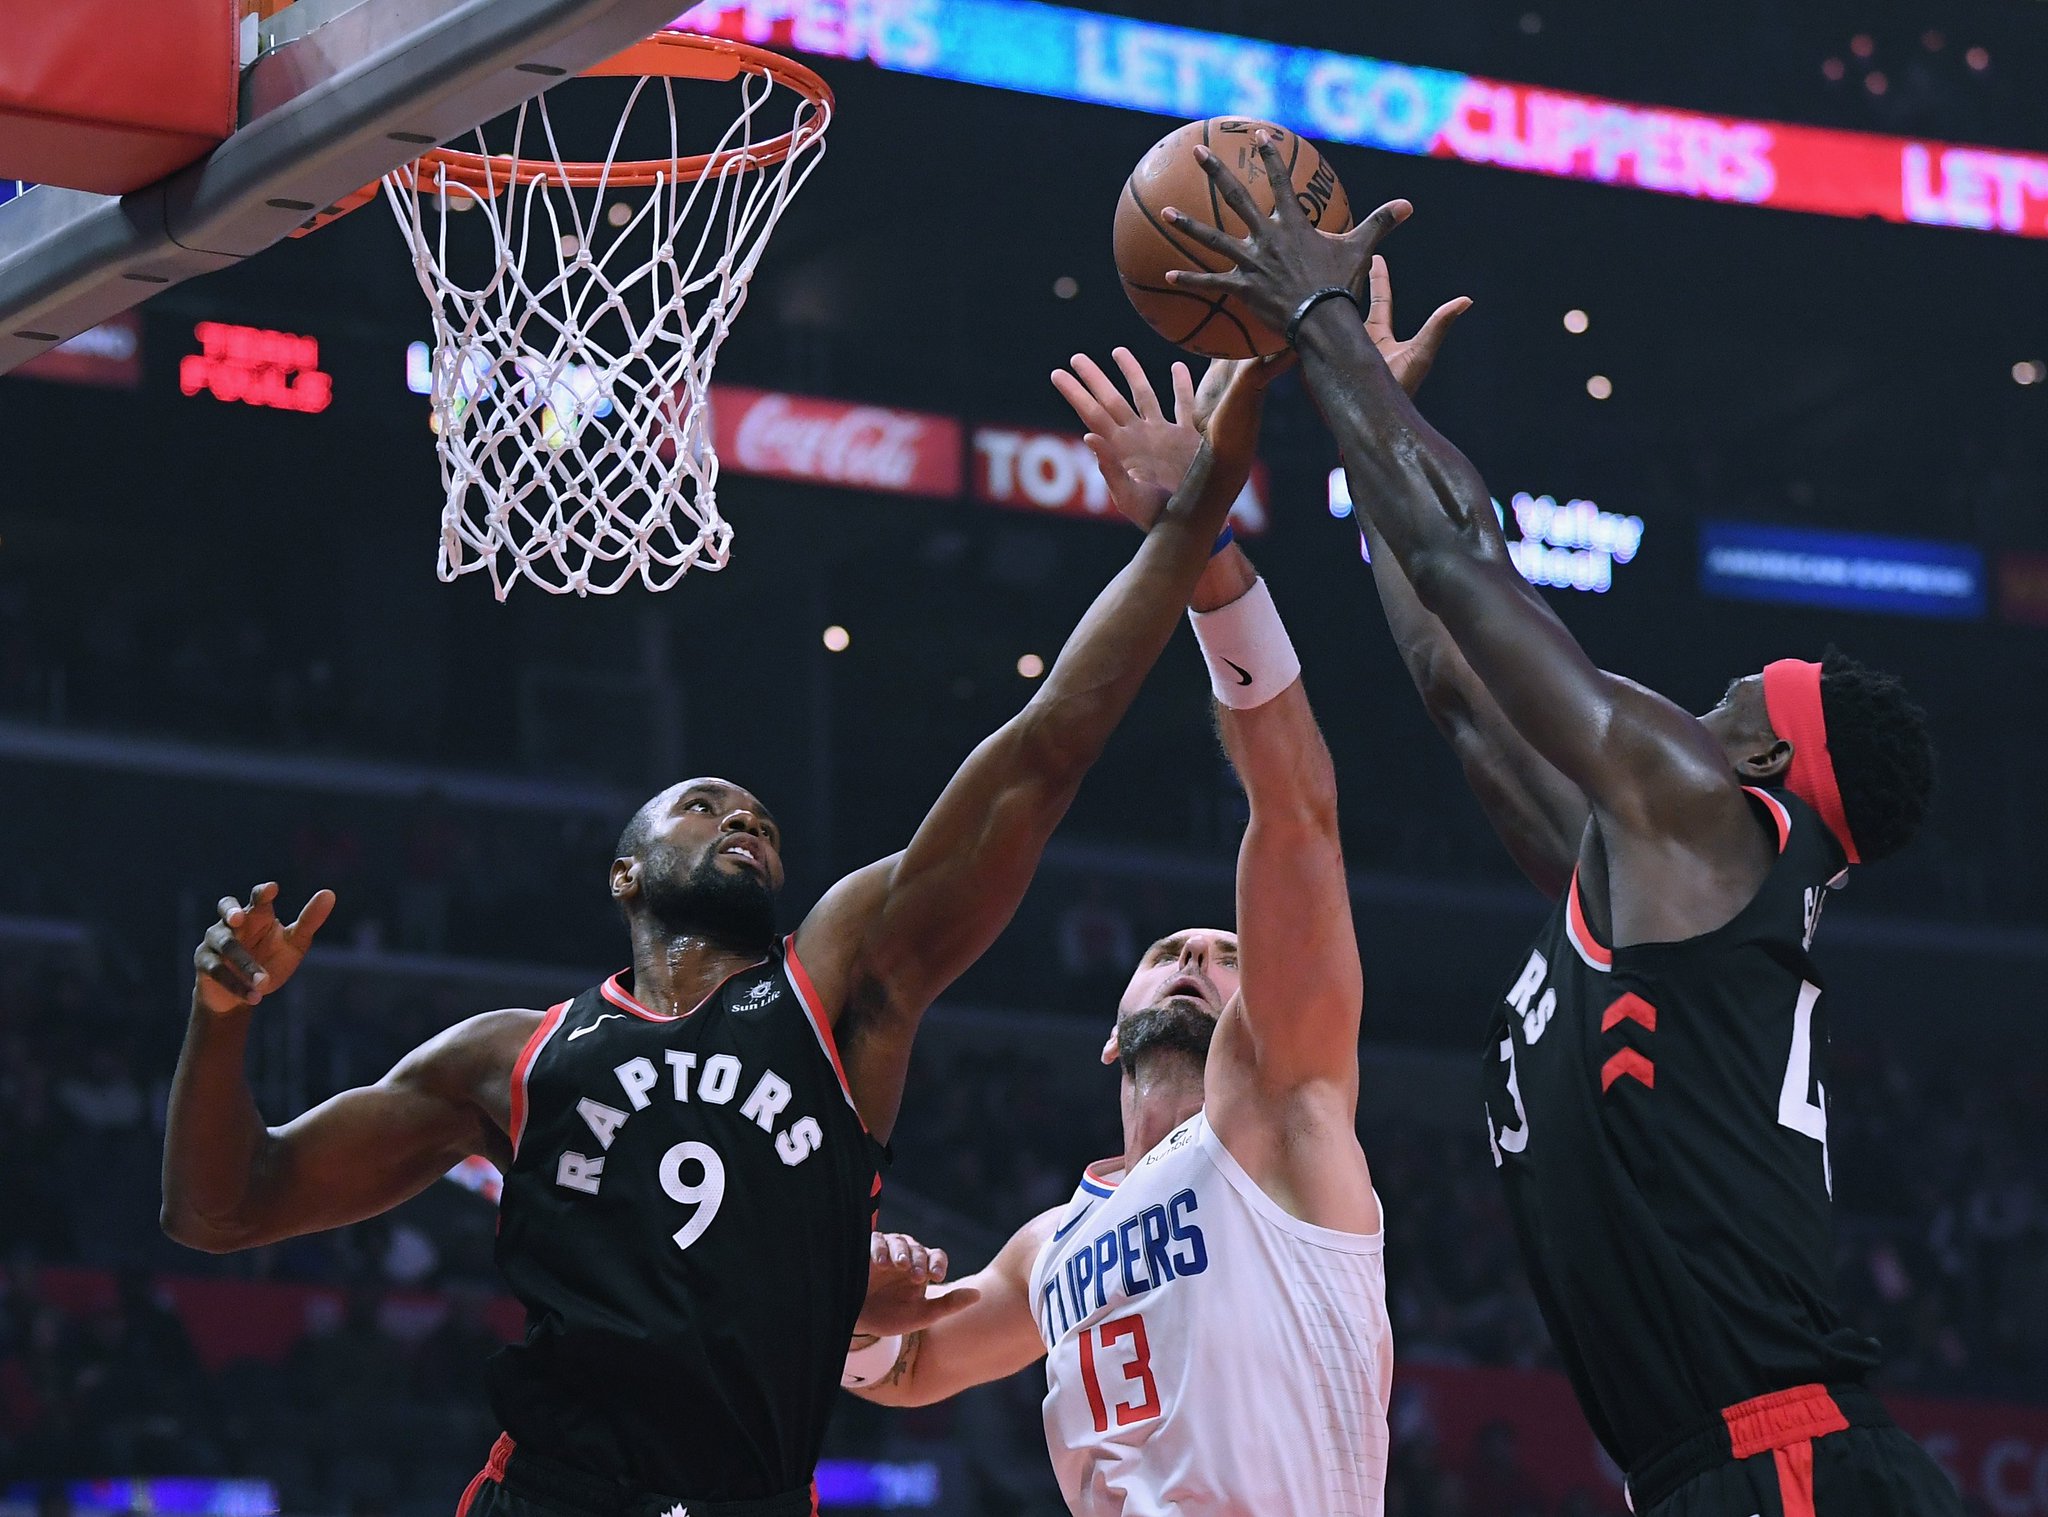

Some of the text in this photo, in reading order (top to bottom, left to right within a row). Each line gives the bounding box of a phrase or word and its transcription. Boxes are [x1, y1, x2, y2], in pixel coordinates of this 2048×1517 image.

[1306, 58, 1428, 142] GO
[1450, 78, 1776, 204] CLIPPERS
[731, 1003, 758, 1012] Sun
[556, 1049, 823, 1195] RAPTORS
[659, 1141, 725, 1250] 9
[1078, 1314, 1161, 1433] 13
